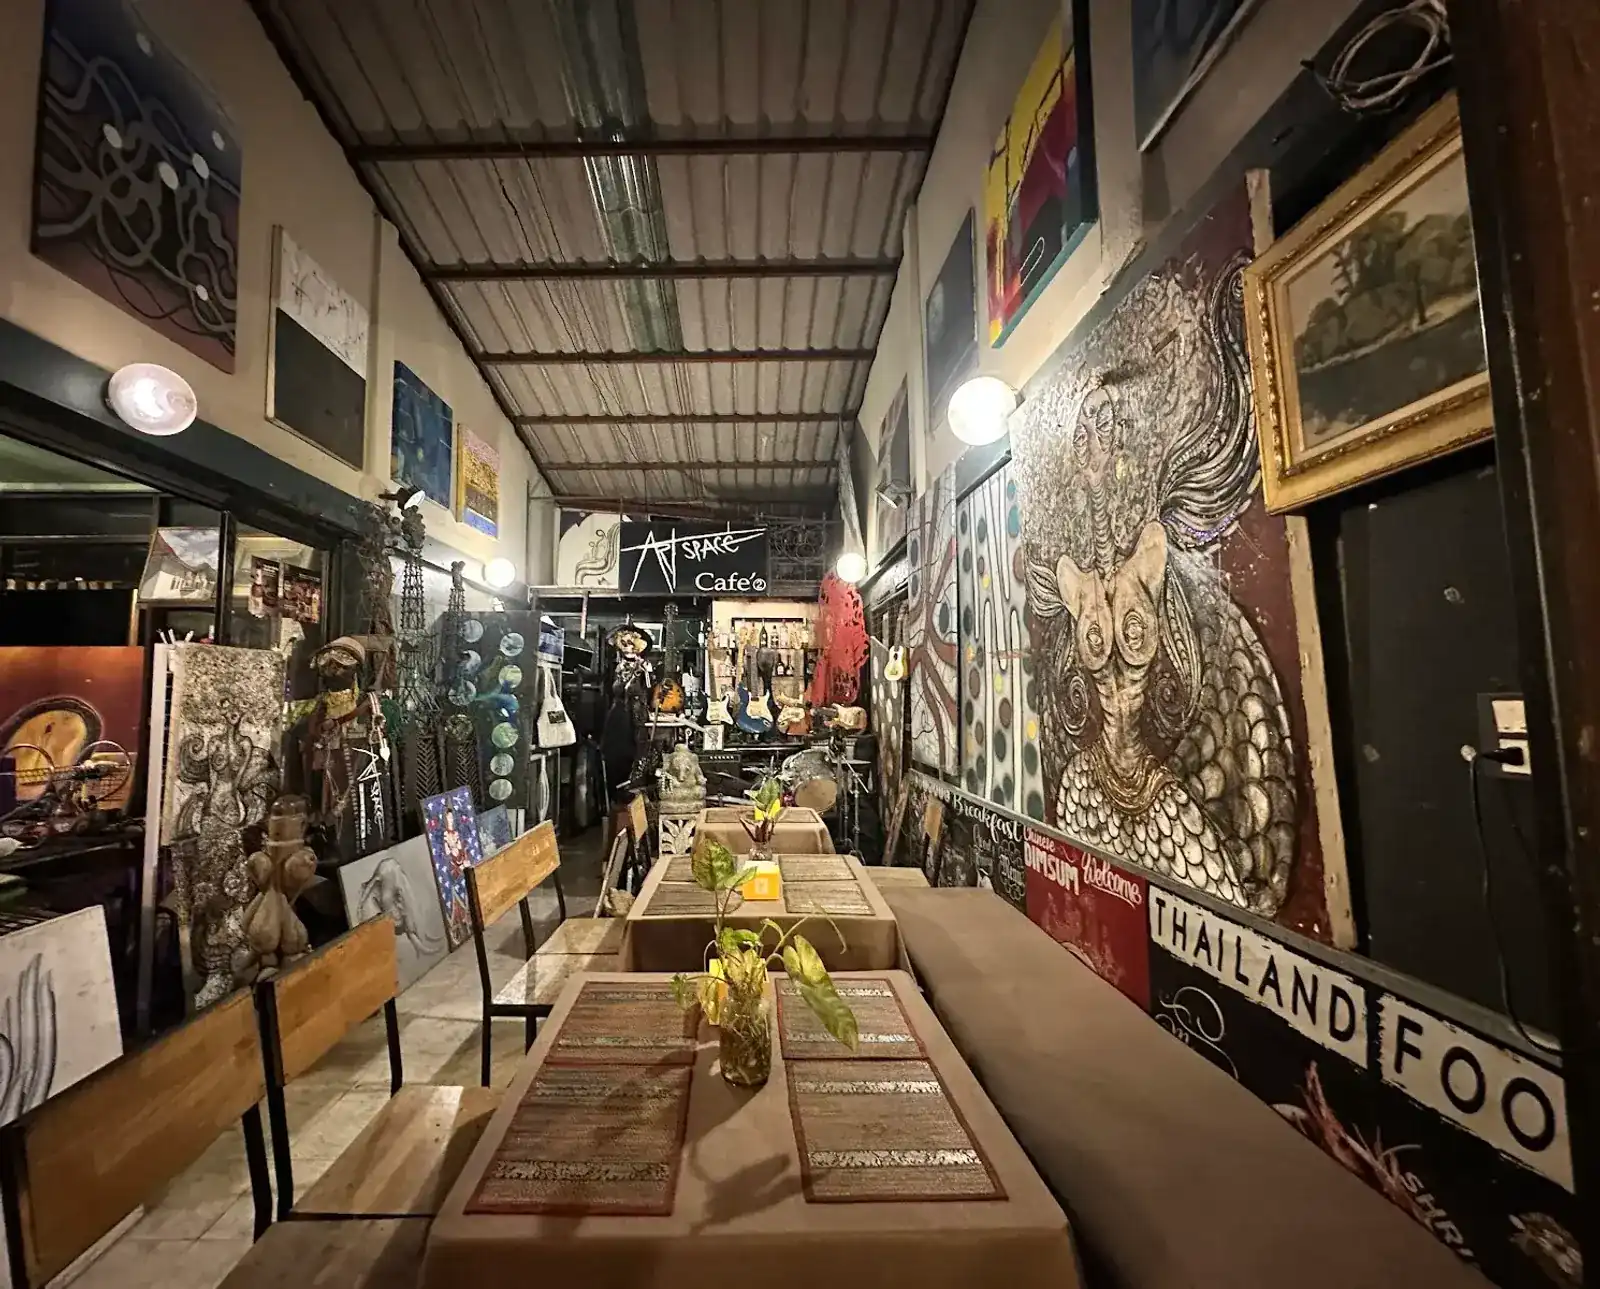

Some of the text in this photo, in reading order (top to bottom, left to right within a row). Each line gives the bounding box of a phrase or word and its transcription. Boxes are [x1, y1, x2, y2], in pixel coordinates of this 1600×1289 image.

[953, 792, 1023, 843] Breakfast
[1024, 841, 1080, 896] DIMSUM
[1081, 851, 1143, 907] Welcome
[1156, 899, 1356, 1043] THAILAND
